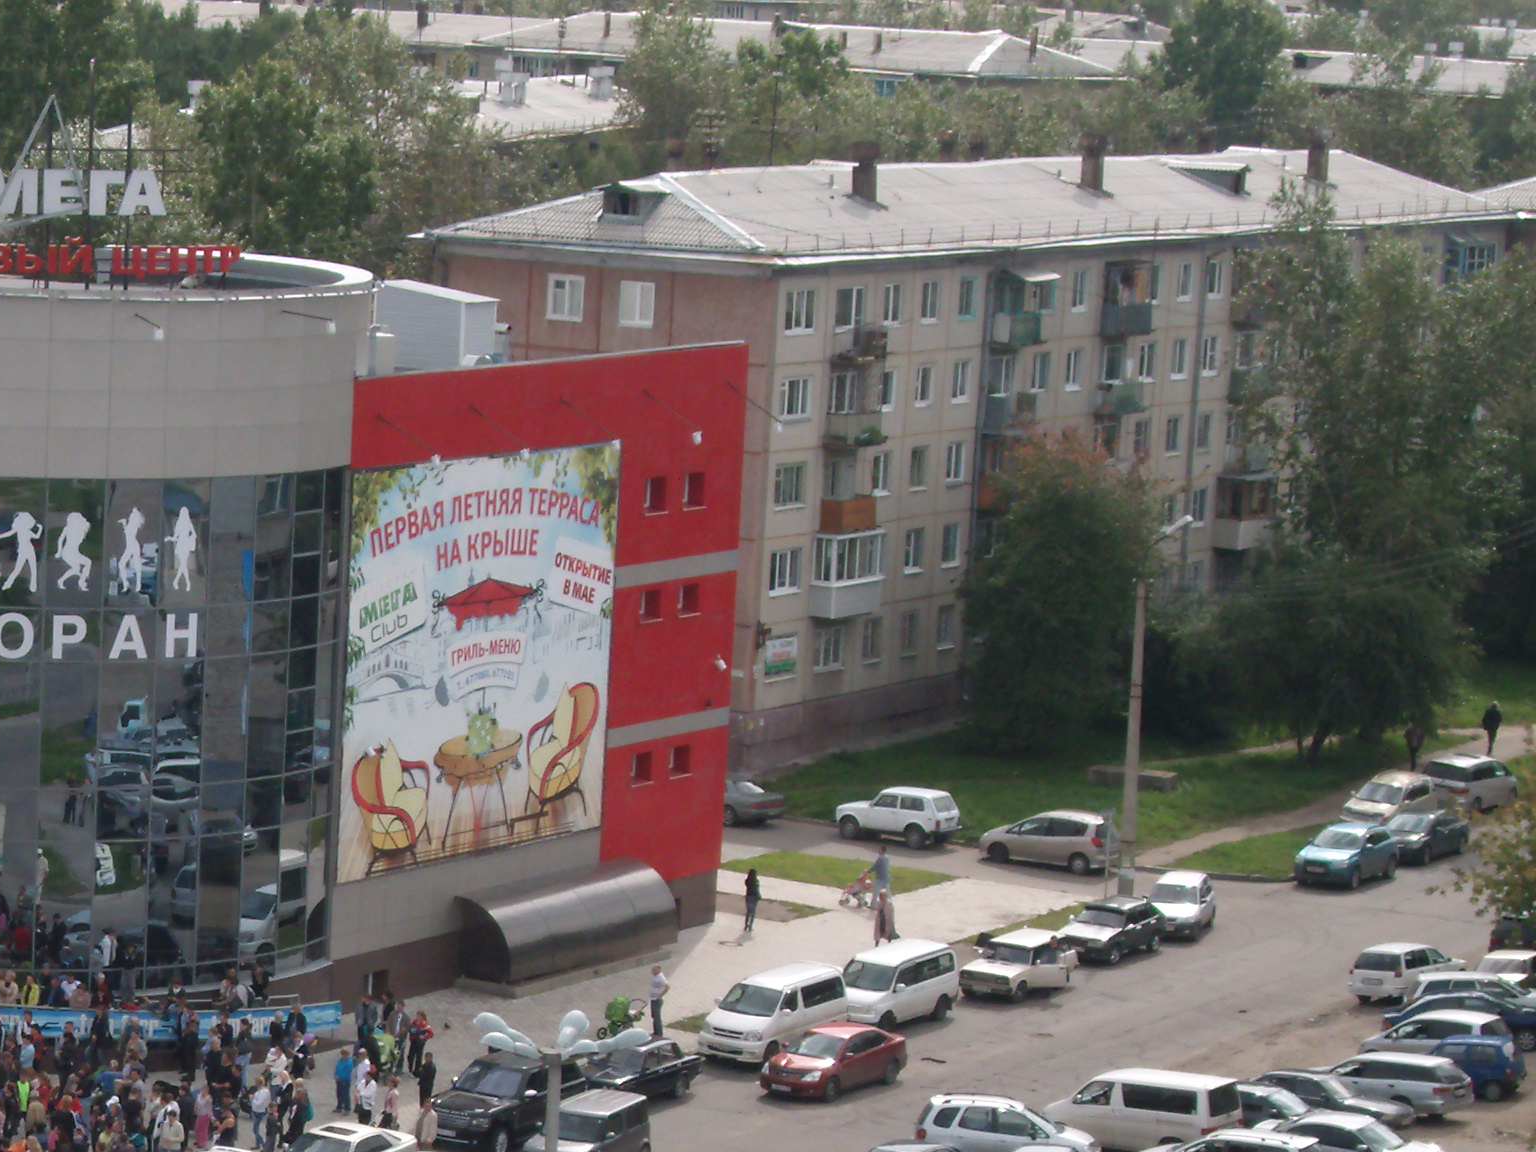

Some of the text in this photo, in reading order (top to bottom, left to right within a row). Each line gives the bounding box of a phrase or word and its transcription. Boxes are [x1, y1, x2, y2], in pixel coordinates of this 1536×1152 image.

[111, 244, 242, 280] ЦЕНТР
[370, 487, 601, 558] ПЕРВАЯ ЛЕТНЯЯ ТЕРРАСА
[436, 529, 541, 572] НА КРЫШЕ
[554, 552, 612, 586] ОТКРЫТИЕ
[359, 582, 418, 630] МЕГА
[562, 579, 596, 605] В МАЕ
[371, 614, 408, 643] Club
[450, 639, 522, 667] ГРИЛЬ-МЕНЮ
